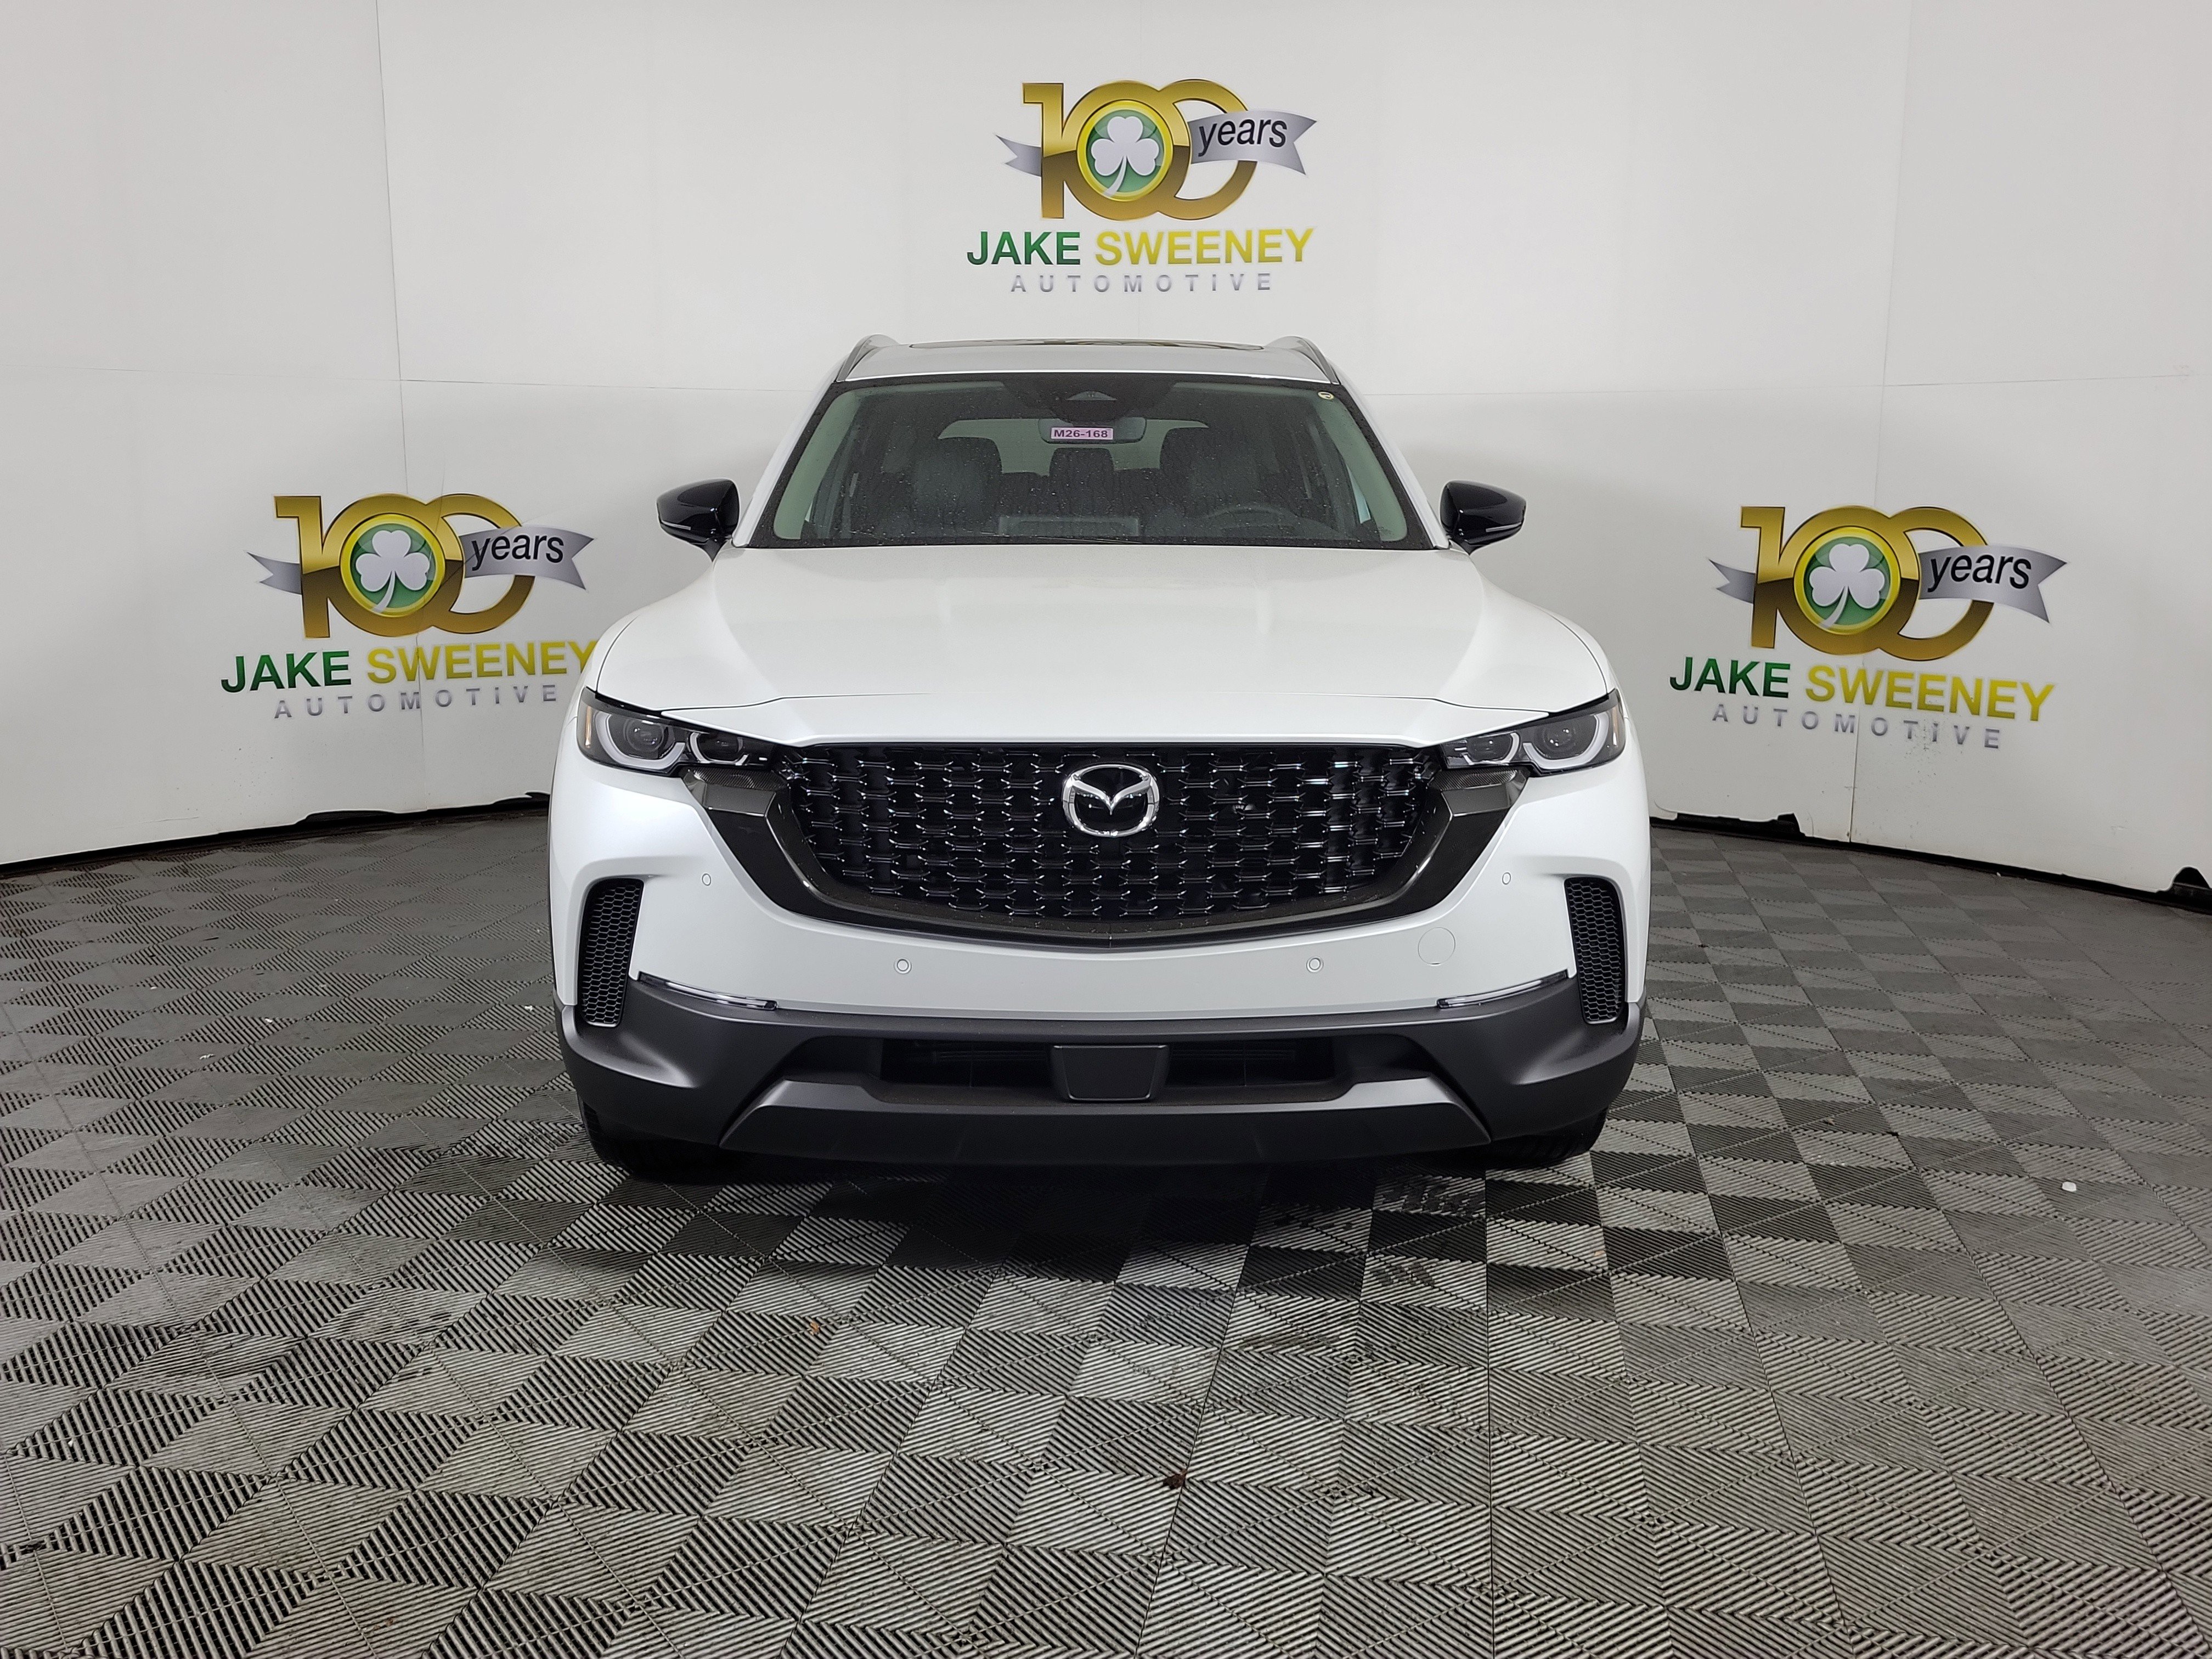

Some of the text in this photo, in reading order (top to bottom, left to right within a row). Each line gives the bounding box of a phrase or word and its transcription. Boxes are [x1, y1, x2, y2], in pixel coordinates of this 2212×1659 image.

[1022, 78, 1288, 221] 100 years
[967, 228, 1314, 266] JAKE SWEENEY
[1011, 273, 1271, 292] AUTOMOTIVE
[1054, 429, 1108, 438] M26-168
[274, 493, 565, 638] 100 years
[1740, 505, 2032, 661] 100 years
[221, 640, 597, 693] JAKE SWEENEY
[1669, 657, 2055, 721] JAKE SWEENEY
[274, 685, 556, 719] AUTOMOTIVE
[1712, 703, 2000, 749] AUTOMOTIVE
